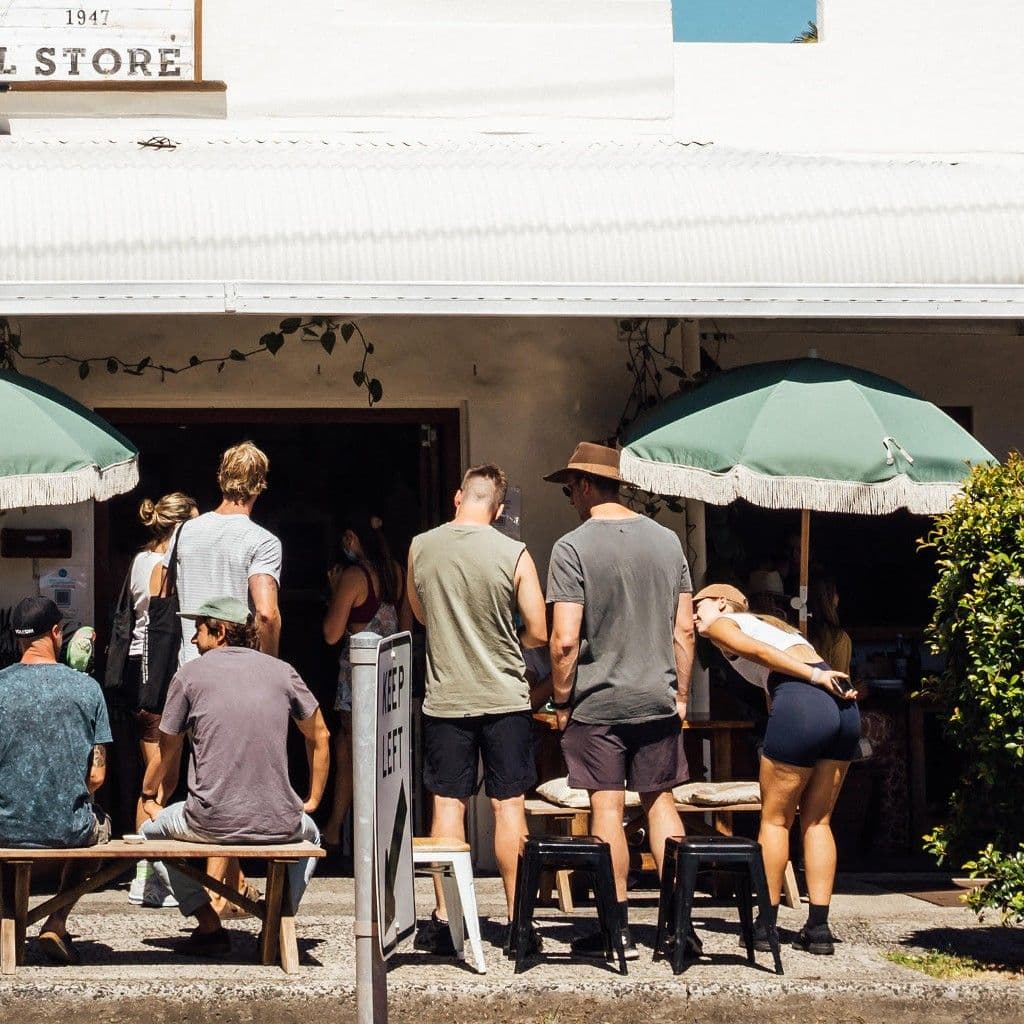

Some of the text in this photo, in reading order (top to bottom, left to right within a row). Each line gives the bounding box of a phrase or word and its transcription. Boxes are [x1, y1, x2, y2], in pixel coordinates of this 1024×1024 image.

[65, 9, 110, 26] 1947
[34, 47, 181, 76] STORE
[382, 665, 405, 715] KEEP
[382, 726, 403, 778] LEFT
